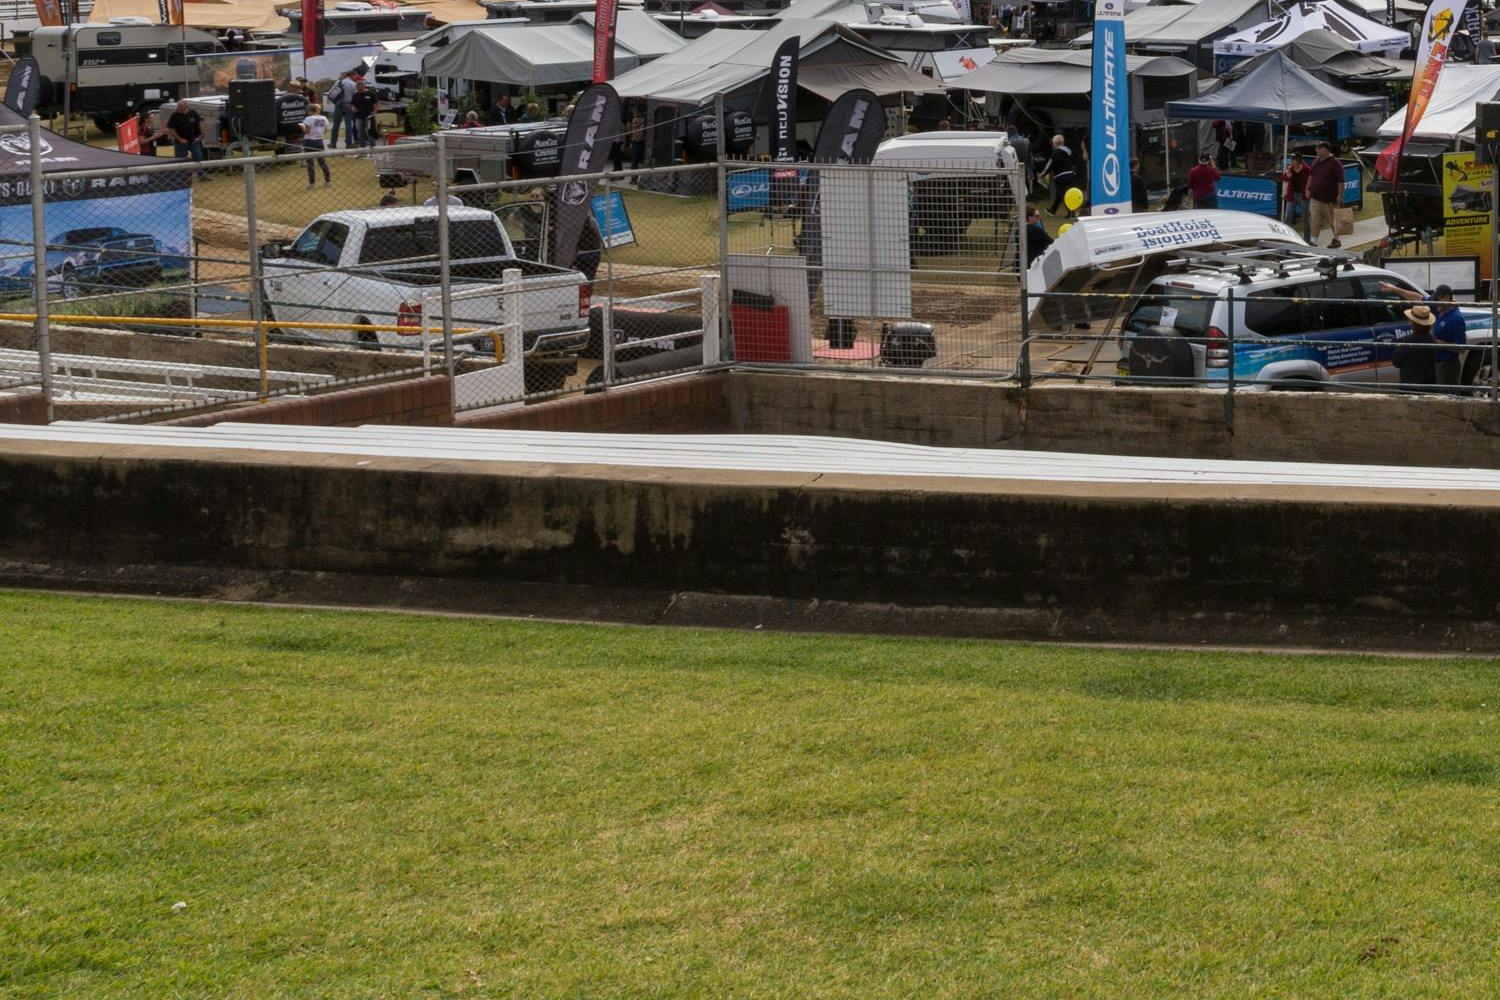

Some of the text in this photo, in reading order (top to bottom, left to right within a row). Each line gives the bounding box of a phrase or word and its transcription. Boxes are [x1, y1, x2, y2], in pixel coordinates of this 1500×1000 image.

[577, 94, 607, 170] RAM
[91, 175, 149, 188] RAM
[1132, 218, 1215, 239] BoatHoist
[1446, 216, 1489, 226] ADVENTURE
[1142, 229, 1222, 250] BoatHoist
